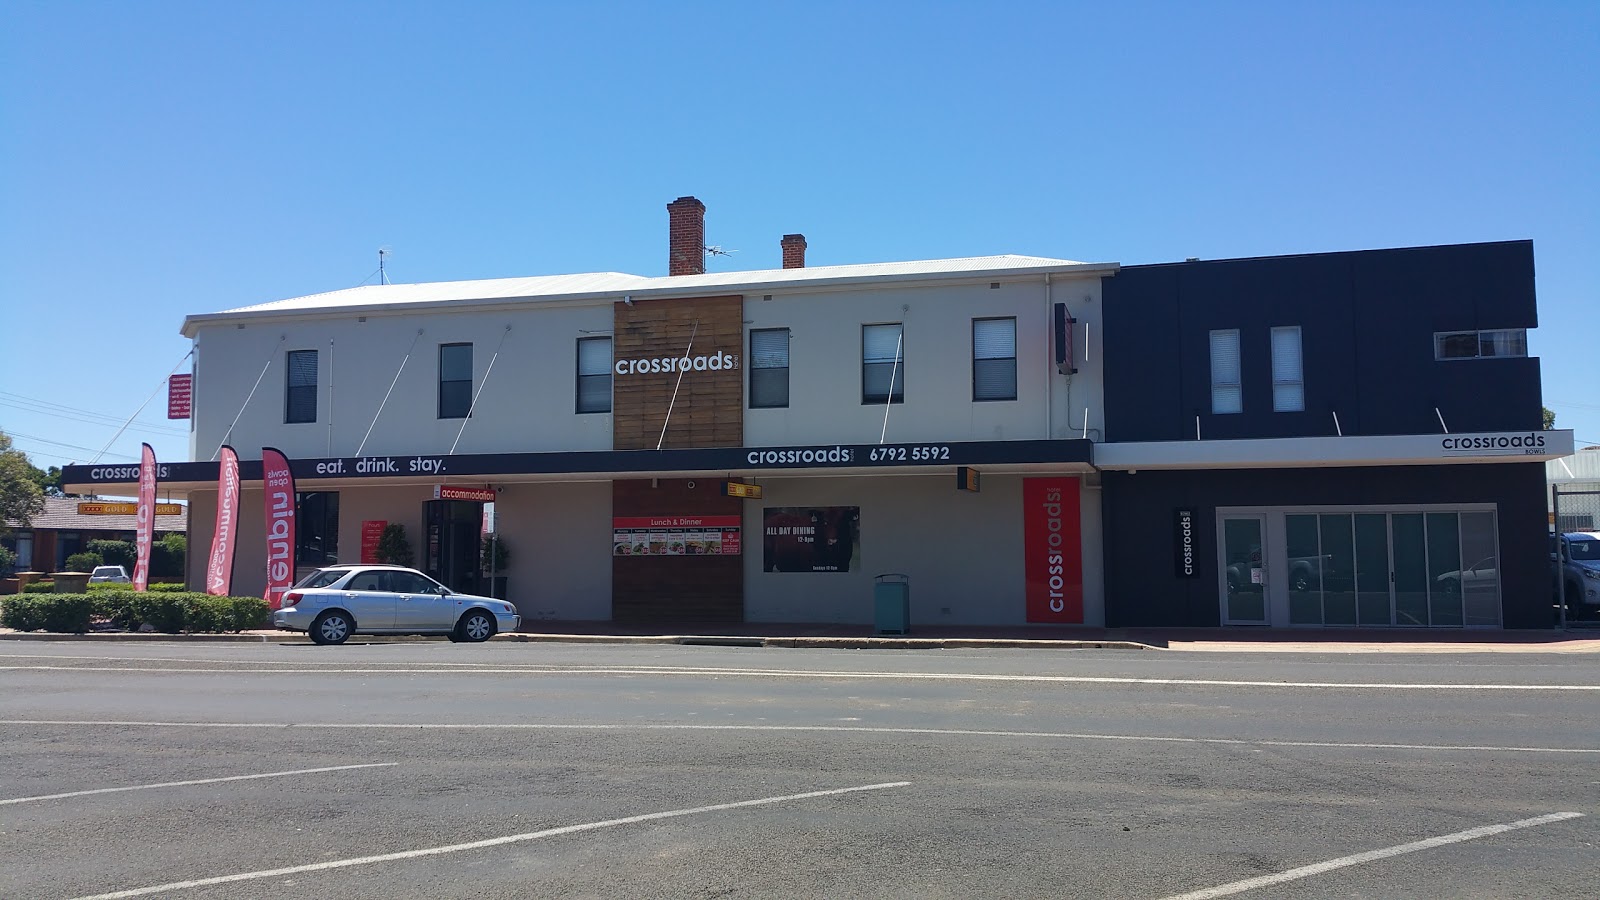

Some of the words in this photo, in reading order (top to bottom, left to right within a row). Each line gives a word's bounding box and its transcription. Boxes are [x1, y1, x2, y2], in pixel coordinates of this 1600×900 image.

[615, 350, 733, 375] crossroads
[1442, 433, 1545, 449] crossroads
[747, 446, 850, 464] crossroads
[869, 447, 907, 461] 6792
[911, 446, 950, 461] 5592
[91, 463, 168, 479] crossros
[316, 459, 347, 474] eat.
[355, 457, 400, 473] drink.
[409, 456, 447, 474] stay.
[441, 488, 495, 501] accommodation
[650, 518, 672, 526] Lunch
[679, 518, 703, 526] Dinner
[766, 526, 778, 535] ALL
[779, 526, 792, 535] DAY
[792, 526, 815, 535] DINING
[1042, 492, 1064, 613] crossroads
[1180, 516, 1193, 575] crossroads
